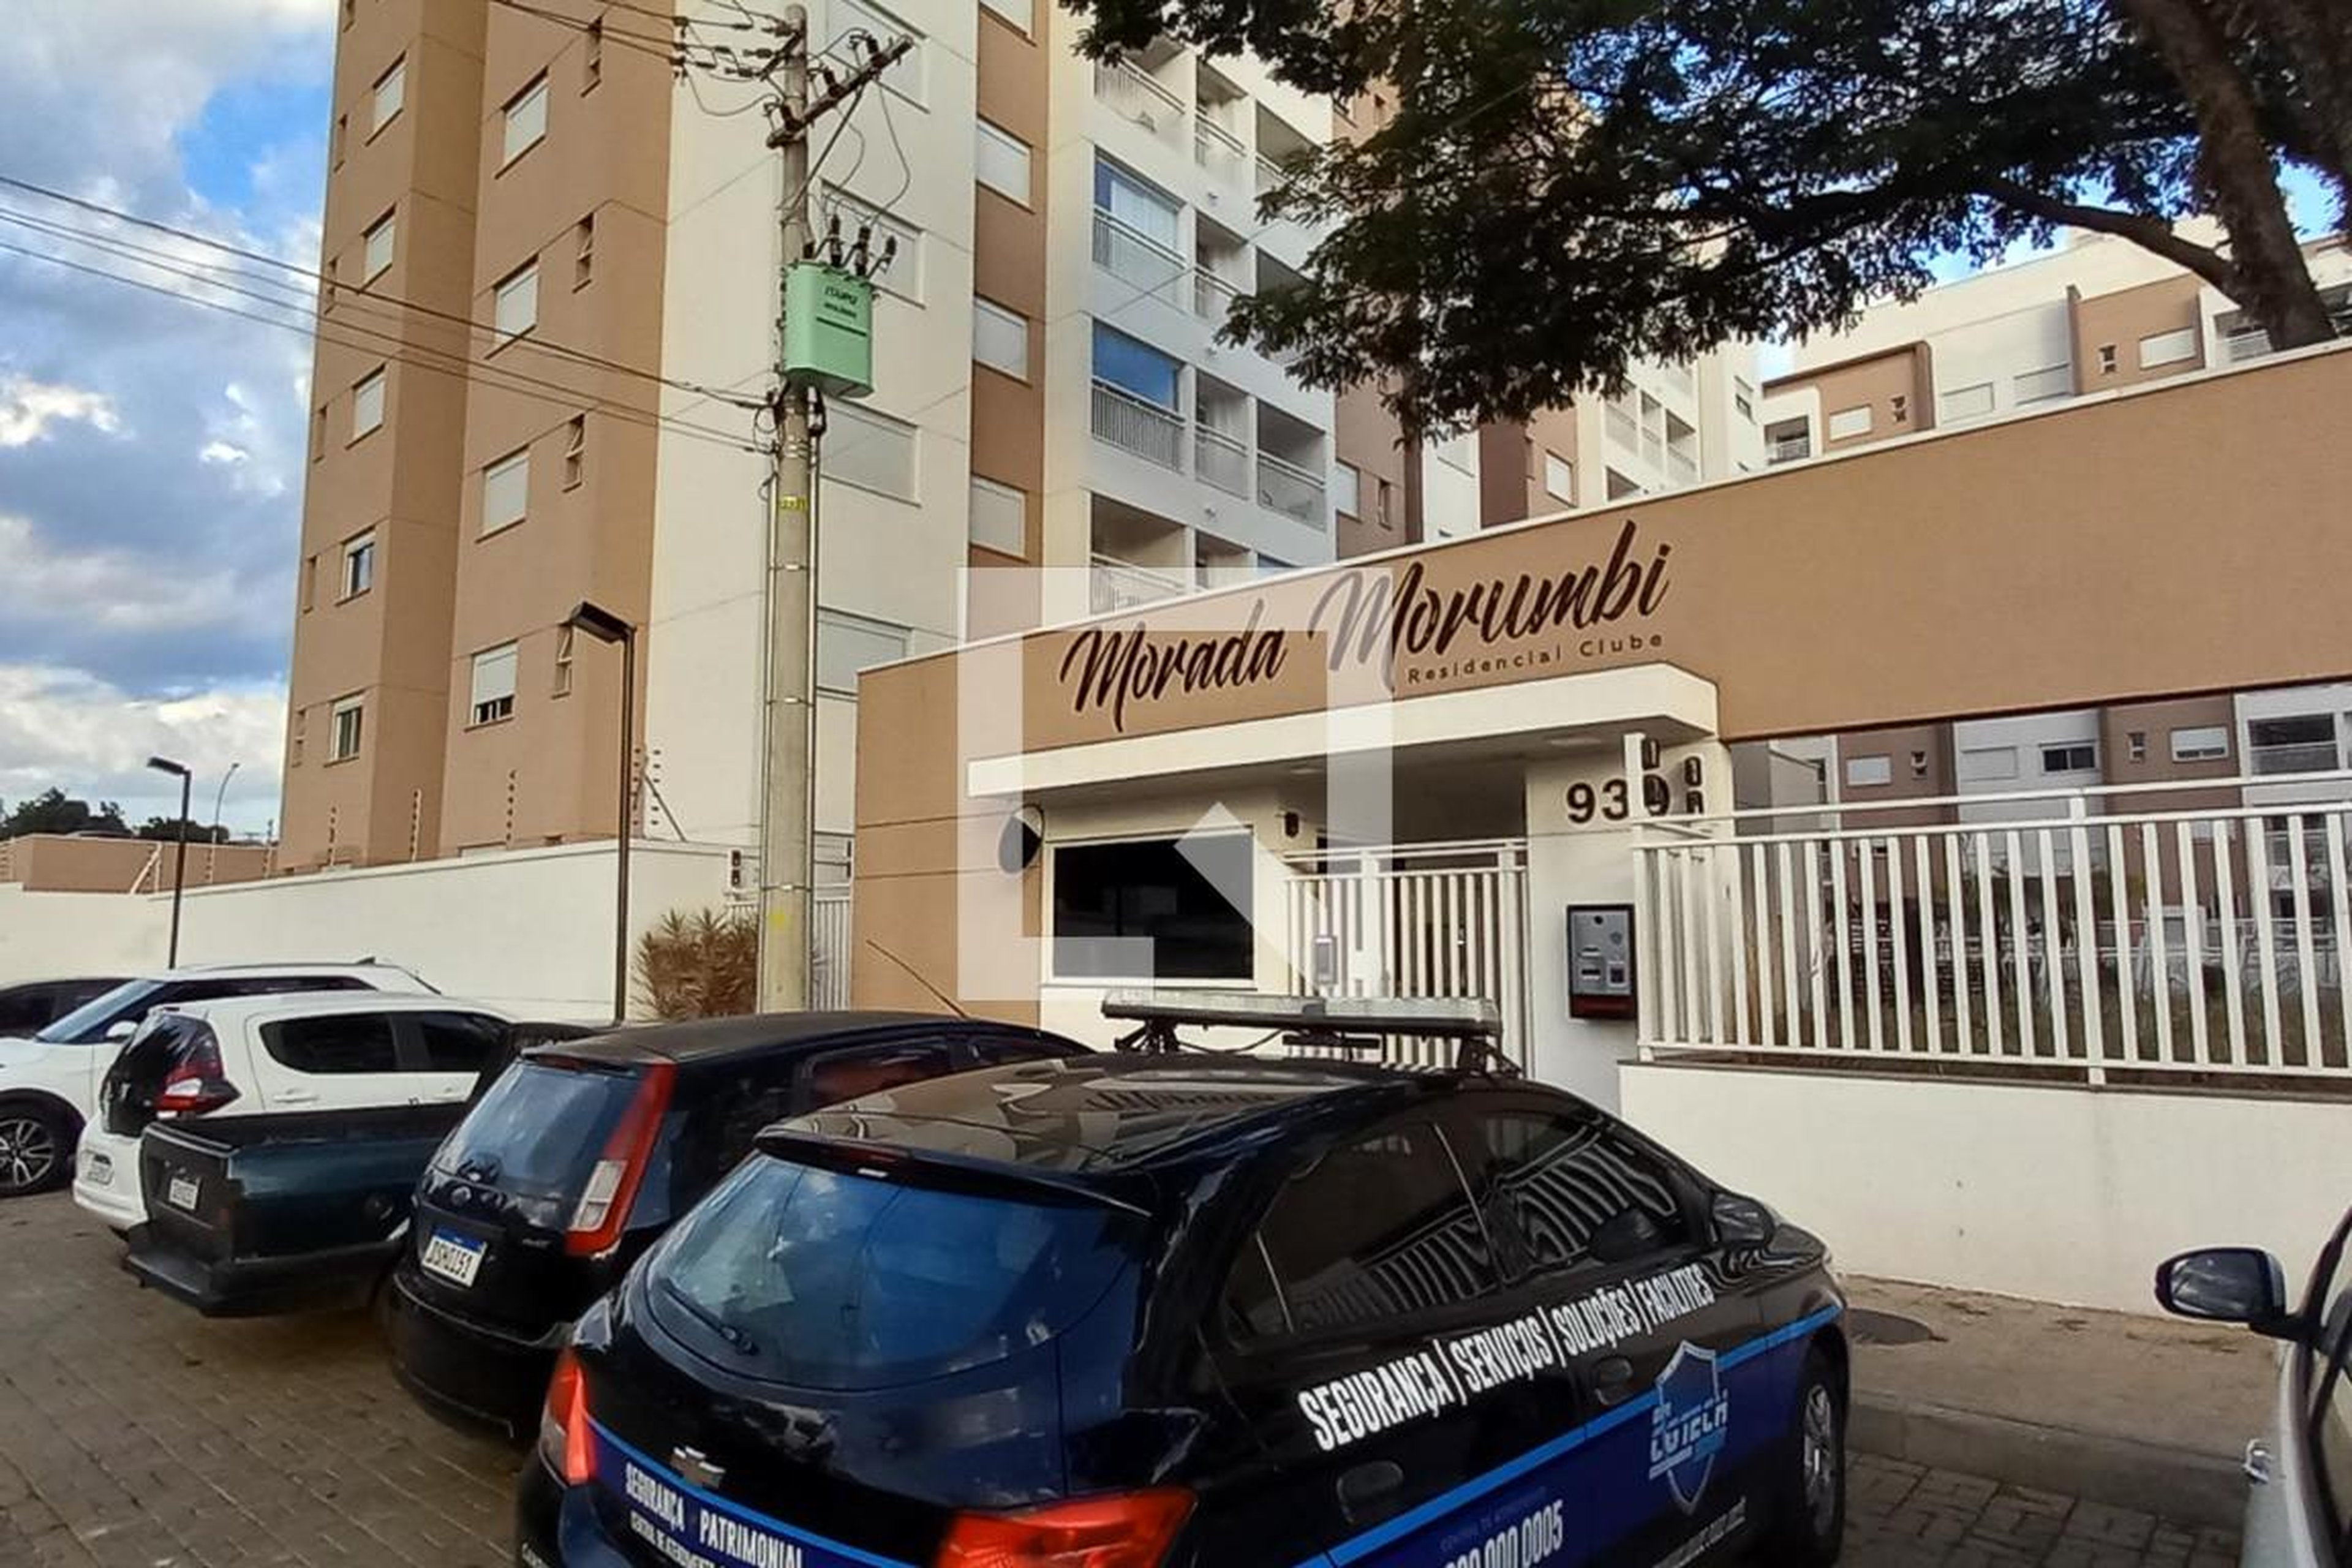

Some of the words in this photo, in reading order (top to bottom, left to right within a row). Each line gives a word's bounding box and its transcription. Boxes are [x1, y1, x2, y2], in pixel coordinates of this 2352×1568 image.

[1060, 598, 1287, 732] Morada
[1308, 520, 1671, 693] Morumbi
[1409, 645, 1561, 684] Residencial
[1580, 635, 1662, 657] Clube
[1297, 1352, 1455, 1451] SEGURANÇA
[1449, 1316, 1554, 1392] SERVIÇOS
[1551, 1287, 1641, 1356] SOLUÇÕES
[1636, 1263, 1714, 1325] FACILITIES
